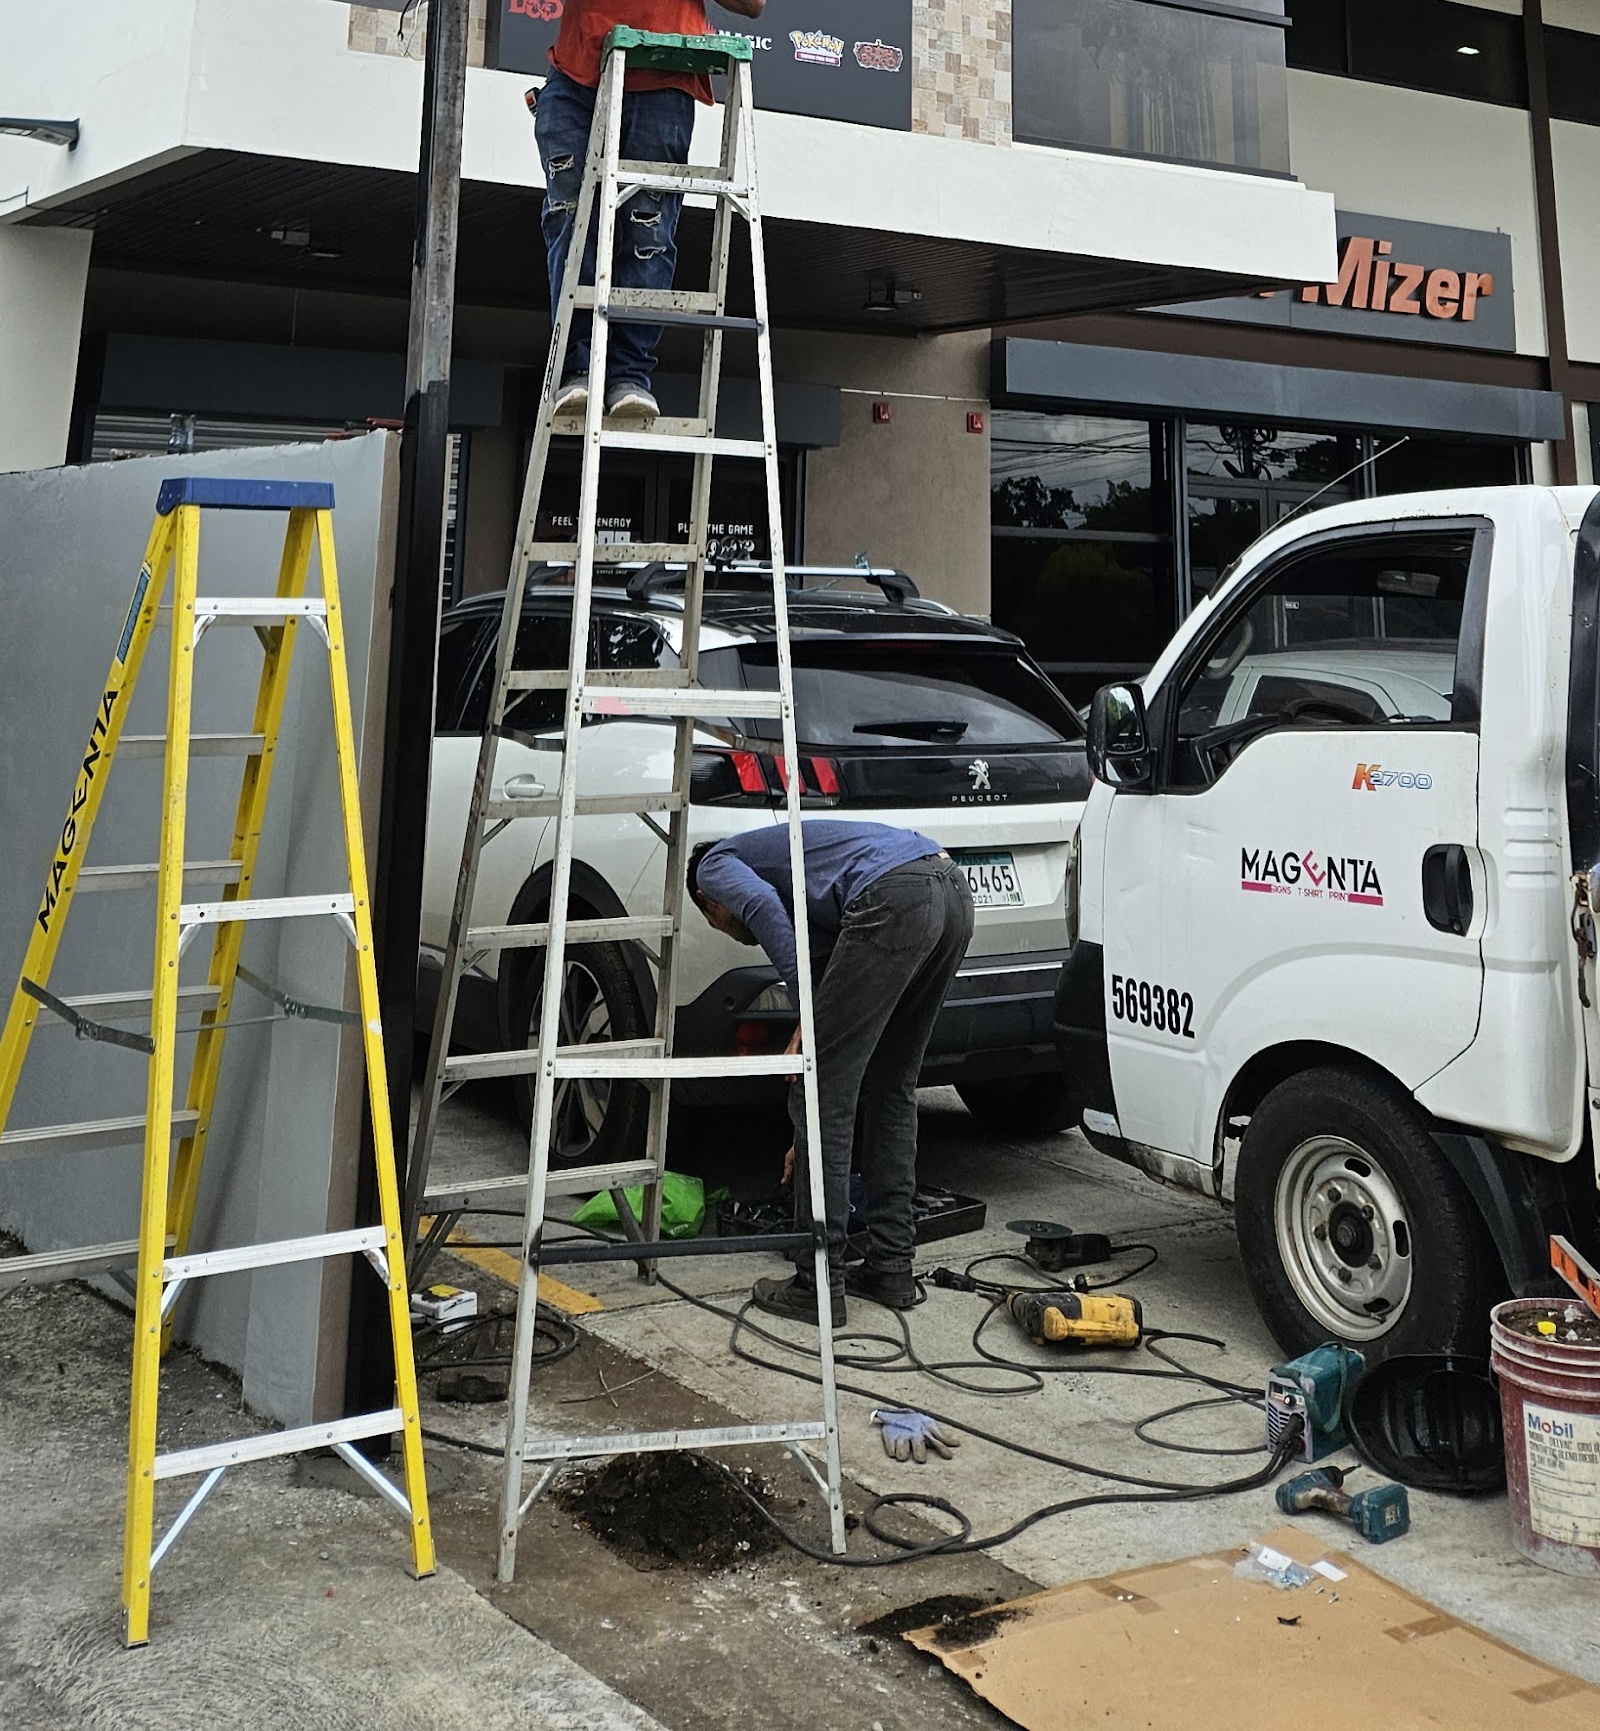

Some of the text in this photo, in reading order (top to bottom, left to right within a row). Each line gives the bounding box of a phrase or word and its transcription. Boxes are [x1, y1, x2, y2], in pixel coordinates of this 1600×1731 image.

[1302, 236, 1494, 321] Mizer
[552, 516, 632, 529] FEEL ENERGY
[728, 524, 754, 535] GAME
[1351, 762, 1433, 792] K2700
[38, 690, 119, 934] MAGENTA
[952, 794, 1008, 803] PEUGEOT
[967, 865, 1015, 894] 6465
[1241, 847, 1383, 895] MAGENTA
[1297, 887, 1324, 899] T-SHIRT
[1111, 973, 1195, 1039] 569382
[1528, 1412, 1574, 1439] Mobil
